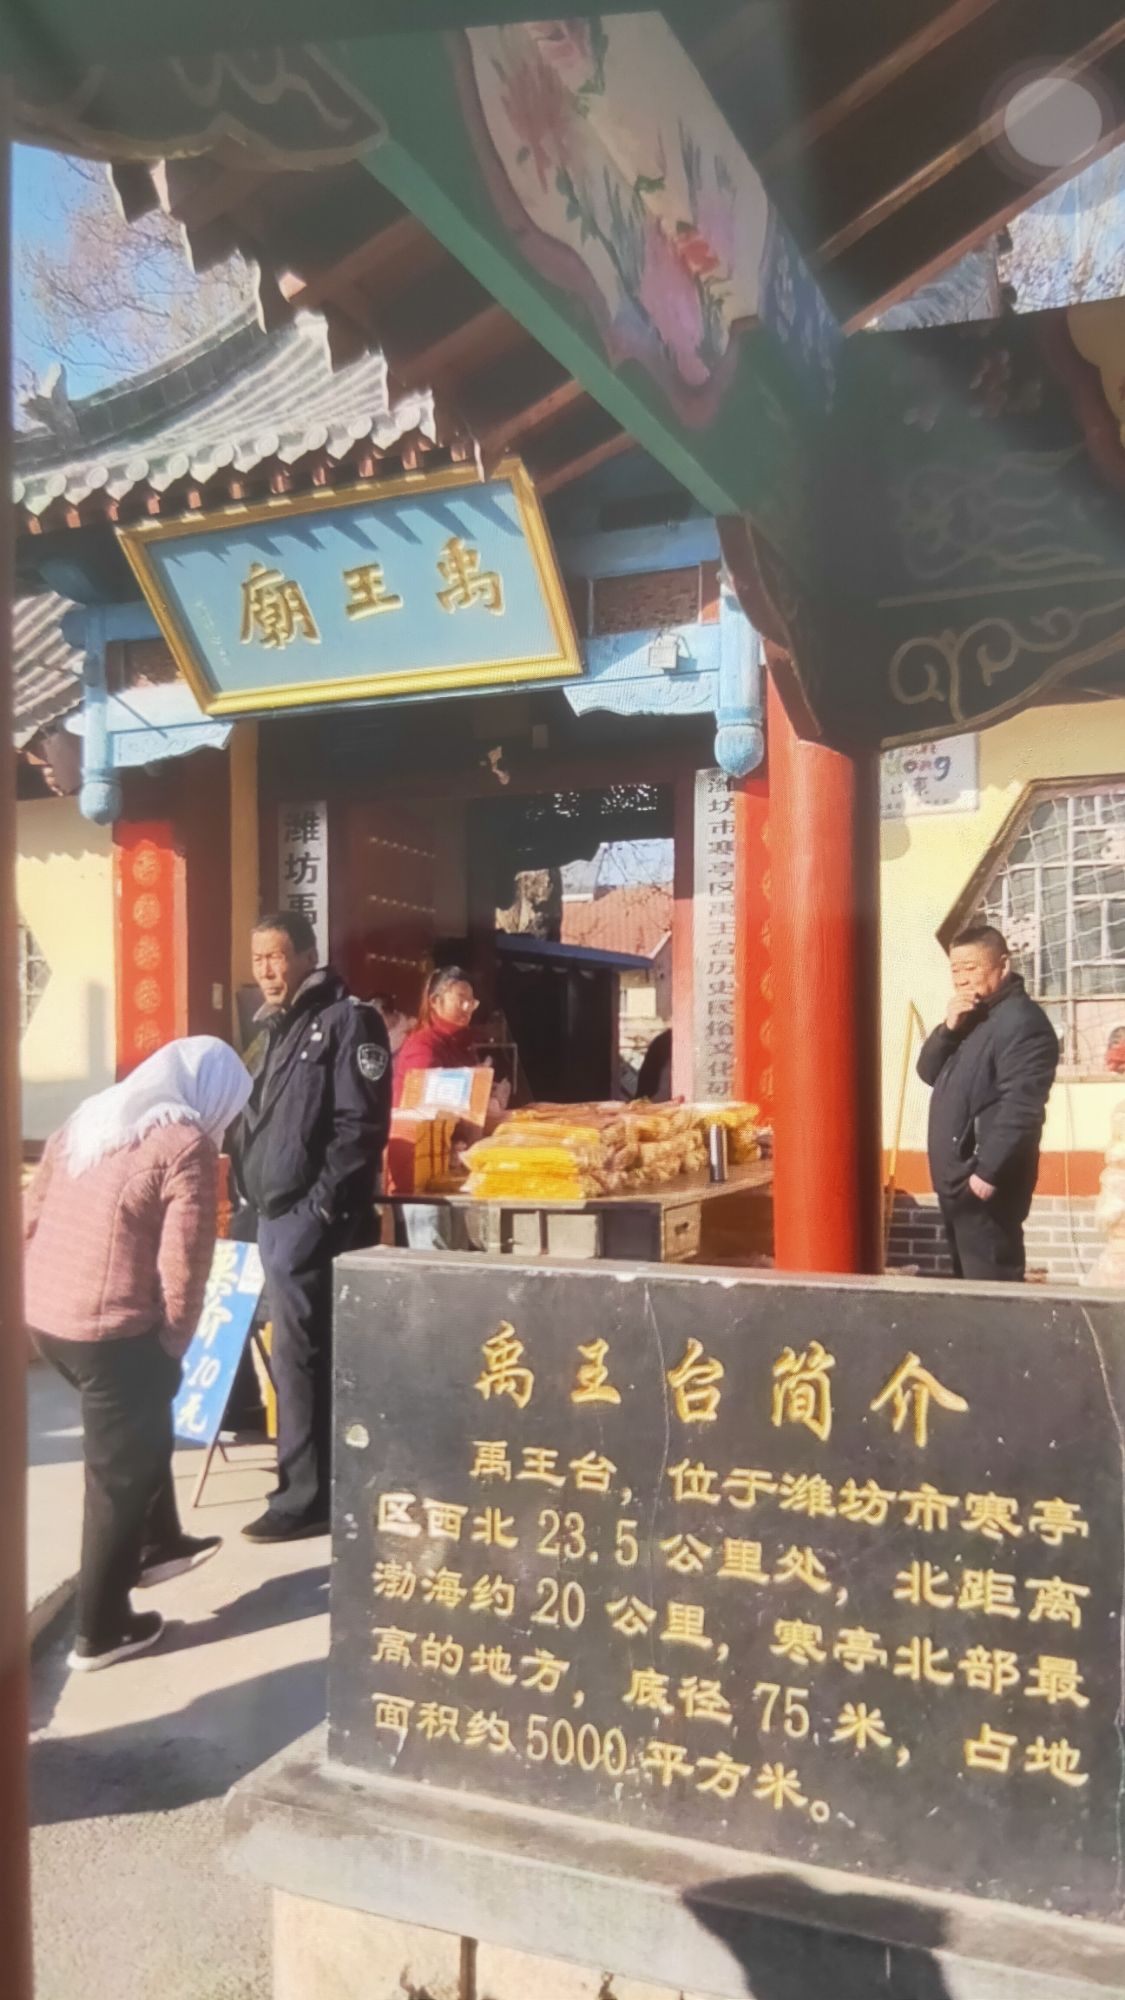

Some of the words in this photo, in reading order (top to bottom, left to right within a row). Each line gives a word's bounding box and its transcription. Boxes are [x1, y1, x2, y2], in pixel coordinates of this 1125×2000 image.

[474, 1320, 969, 1447] 禹王台简介
